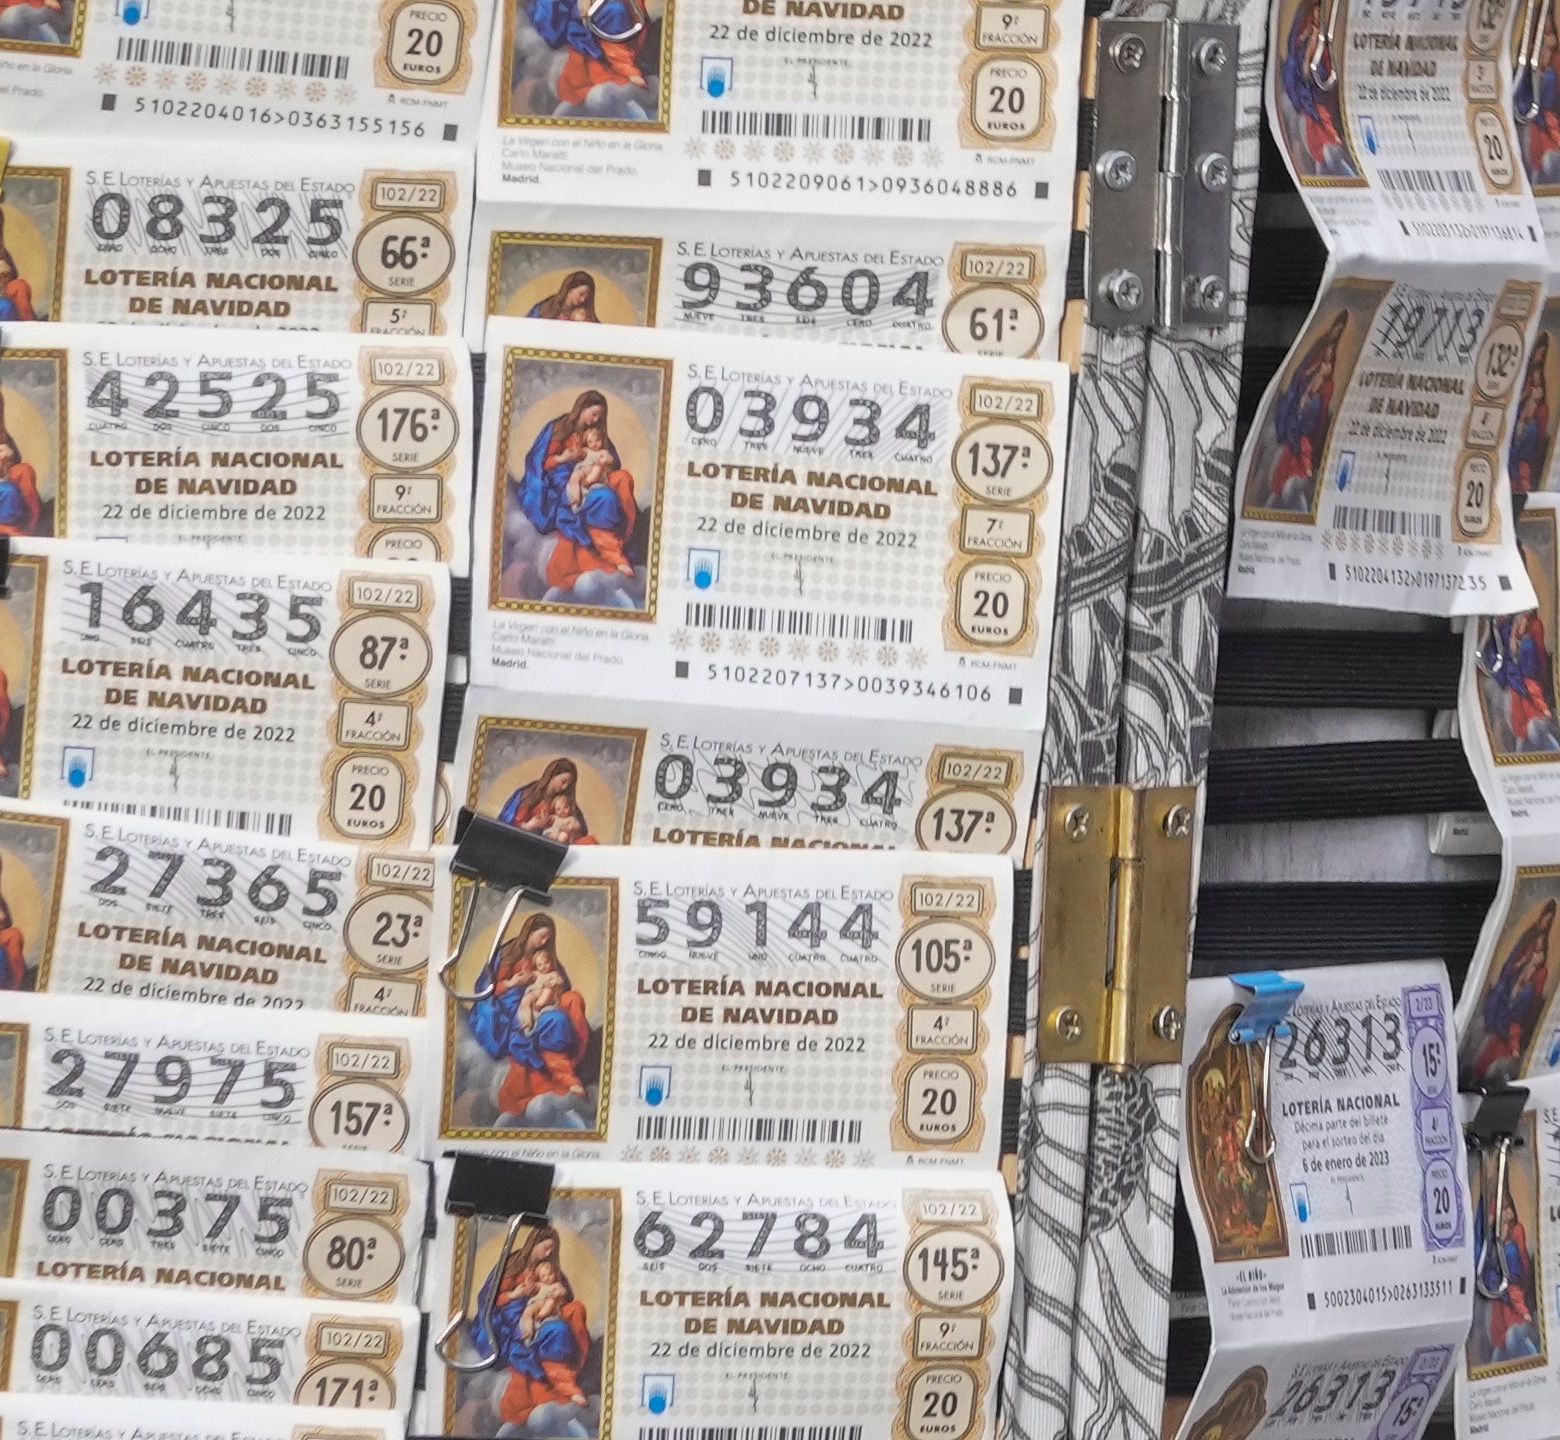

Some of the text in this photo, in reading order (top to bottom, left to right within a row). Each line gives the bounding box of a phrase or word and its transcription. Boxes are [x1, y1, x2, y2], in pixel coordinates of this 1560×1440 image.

[410, 10, 447, 22] PRECIO
[786, 1, 904, 20] NAVIDAD
[406, 29, 442, 56] 20
[403, 64, 441, 74] EUROS
[989, 87, 1024, 113] 20
[987, 121, 1025, 130] EUROS
[1486, 134, 1503, 160] 20
[92, 193, 343, 245] 08325
[85, 268, 338, 292] LOTERÍA NACIONAL
[681, 262, 935, 317] 93604
[130, 297, 291, 316] DE NAVIDAD
[1381, 299, 1485, 354] 19713
[87, 370, 340, 419] 42525
[687, 386, 936, 449] 03934
[90, 448, 343, 468] LOTERÍA NACIONAL
[135, 479, 297, 495] DE NAVIDAD
[688, 462, 938, 496] LOTERÍA NACIONAL
[731, 493, 891, 519] DE NAVIDAD
[1466, 481, 1484, 508] 20
[697, 517, 917, 549] 22 de diciembre de 2022
[80, 582, 323, 643] 16435
[974, 591, 1008, 617] 20
[62, 658, 315, 689] LOTERÍA NACIONAL
[105, 688, 267, 714] DE NAVIDAD
[349, 784, 385, 811] 20
[655, 755, 901, 815] 03934
[90, 846, 341, 918] 27365
[731, 887, 737, 897] Y
[743, 885, 810, 899] APUESTAS
[816, 889, 836, 899] DEL
[840, 886, 893, 901] ESTADO
[636, 898, 879, 949] 59144
[638, 976, 883, 998] LOTERÍA NACIONAL
[681, 1007, 838, 1025] DE NAVIDAD
[1279, 1012, 1403, 1070] 26313
[335, 1054, 390, 1070] 102/22
[47, 1049, 297, 1109] 27975
[922, 1089, 957, 1114] 20
[1281, 1092, 1400, 1117] LOTERÍA NACIONAL
[1303, 1150, 1390, 1171] 6 de enero de 2023
[43, 1186, 292, 1243] 00375
[1433, 1188, 1450, 1215] 20
[634, 1211, 884, 1258] 62784
[36, 1261, 286, 1291] LOTERÍA NACIONAL
[641, 1287, 891, 1308] LOTERÍA NACIONAL
[685, 1318, 845, 1335] DE NAVIDAD
[31, 1324, 283, 1384] 00685
[923, 1392, 958, 1417] 20
[1271, 1370, 1396, 1418] 26313
